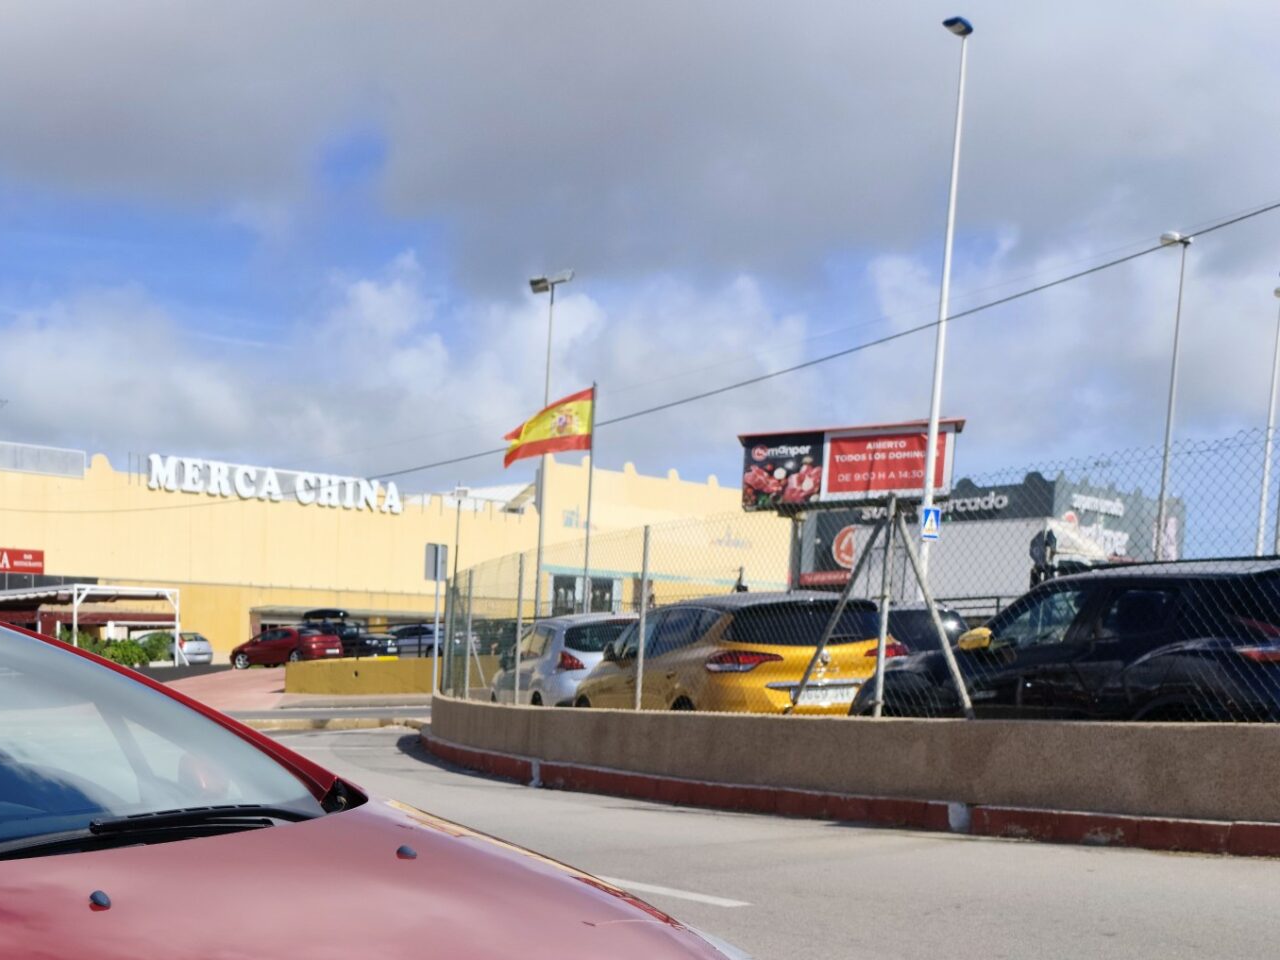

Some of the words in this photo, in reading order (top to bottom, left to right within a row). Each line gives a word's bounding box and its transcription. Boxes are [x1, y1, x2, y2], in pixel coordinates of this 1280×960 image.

[835, 452, 866, 463] TODOS
[868, 451, 885, 462] LOS
[837, 472, 852, 483] DE
[148, 453, 284, 502] MERCA
[294, 471, 402, 515] CHINA
